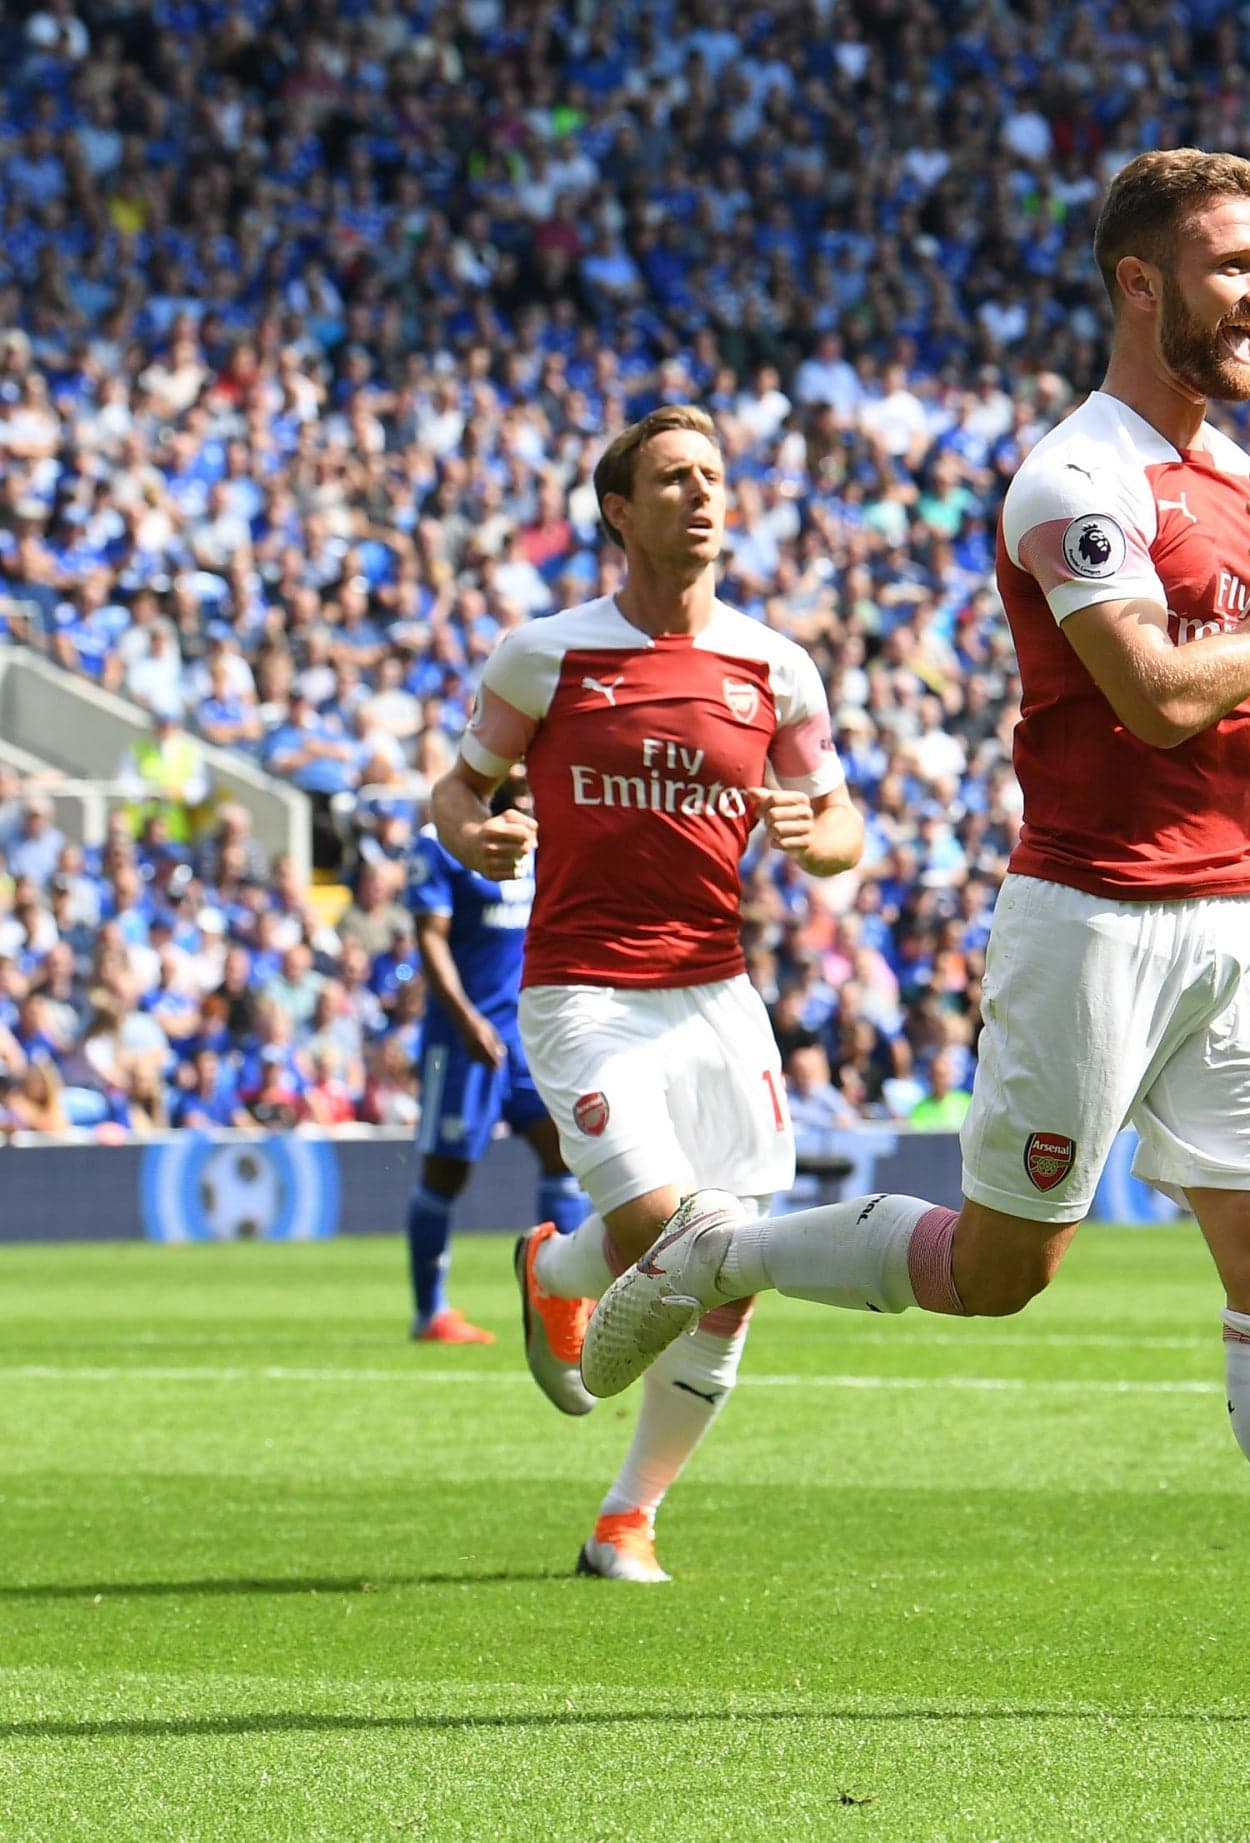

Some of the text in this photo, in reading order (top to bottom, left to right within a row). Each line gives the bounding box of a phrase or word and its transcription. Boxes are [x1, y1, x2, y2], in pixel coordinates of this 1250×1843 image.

[641, 738, 705, 776] Fly
[762, 1070, 786, 1133] 1
[1032, 1140, 1070, 1155] Arsenal
